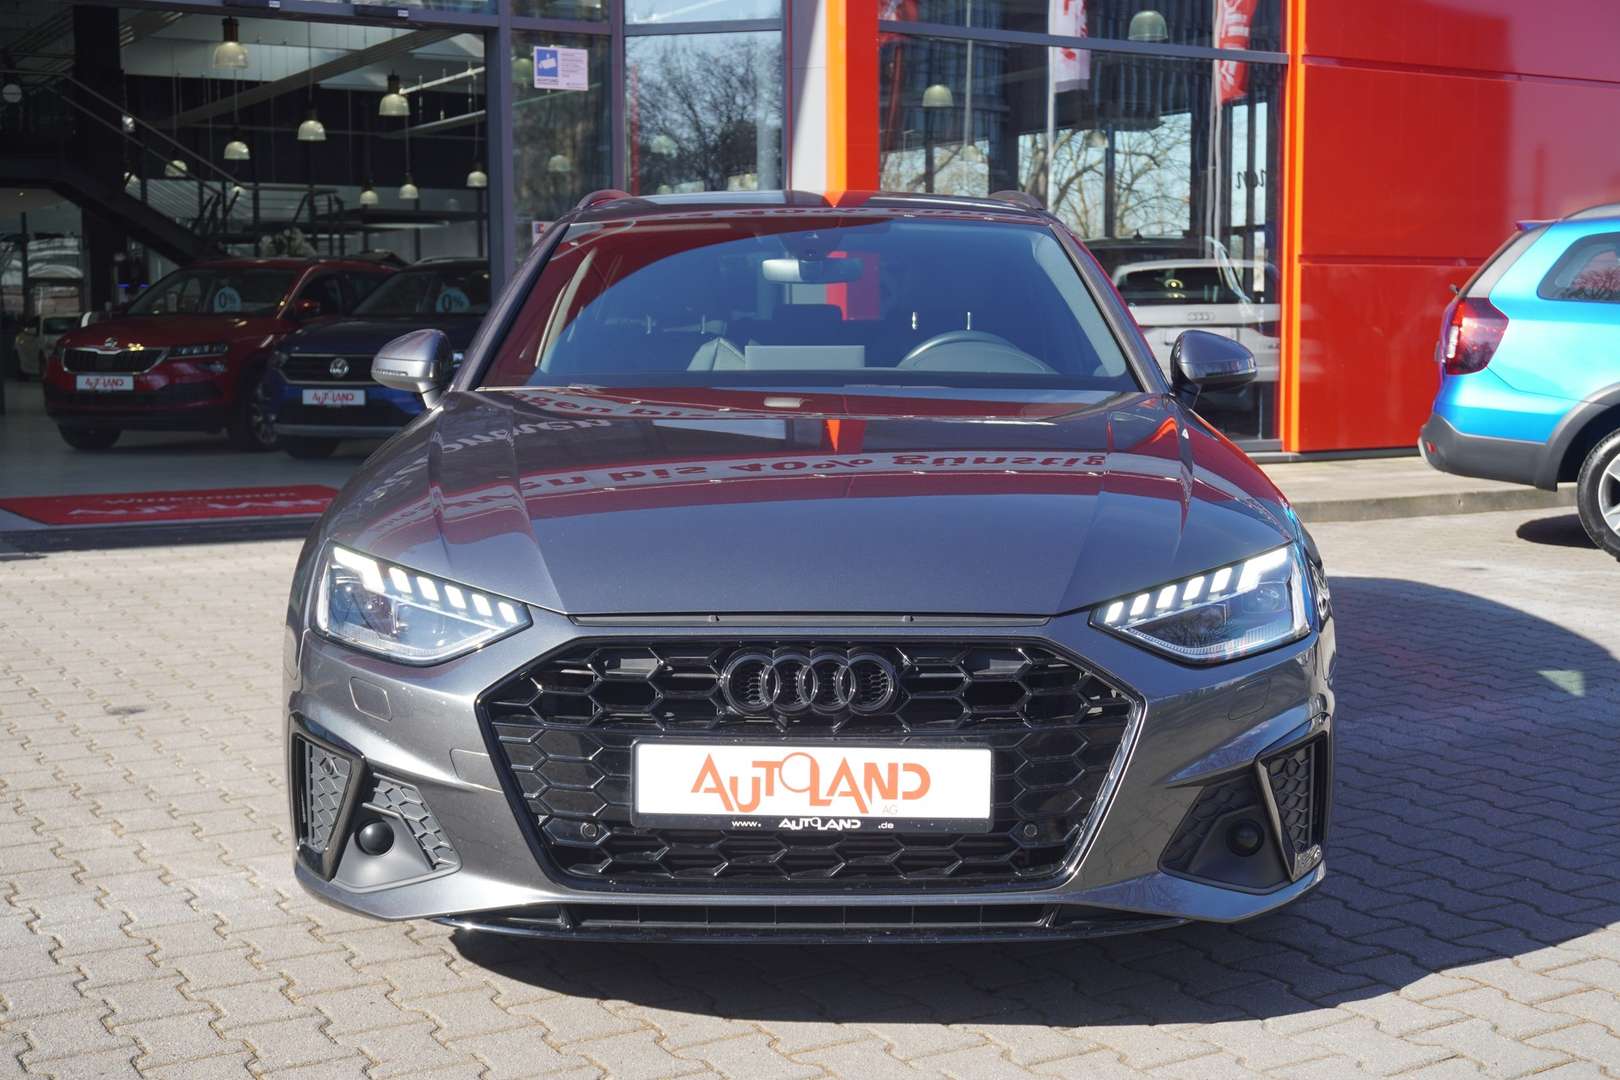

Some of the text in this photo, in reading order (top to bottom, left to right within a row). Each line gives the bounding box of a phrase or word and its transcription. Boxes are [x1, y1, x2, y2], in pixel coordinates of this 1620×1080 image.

[85, 377, 124, 388] AUTLAND
[882, 804, 899, 815] AG
[778, 817, 862, 830] AUTOLAND
[878, 821, 894, 830] .de
